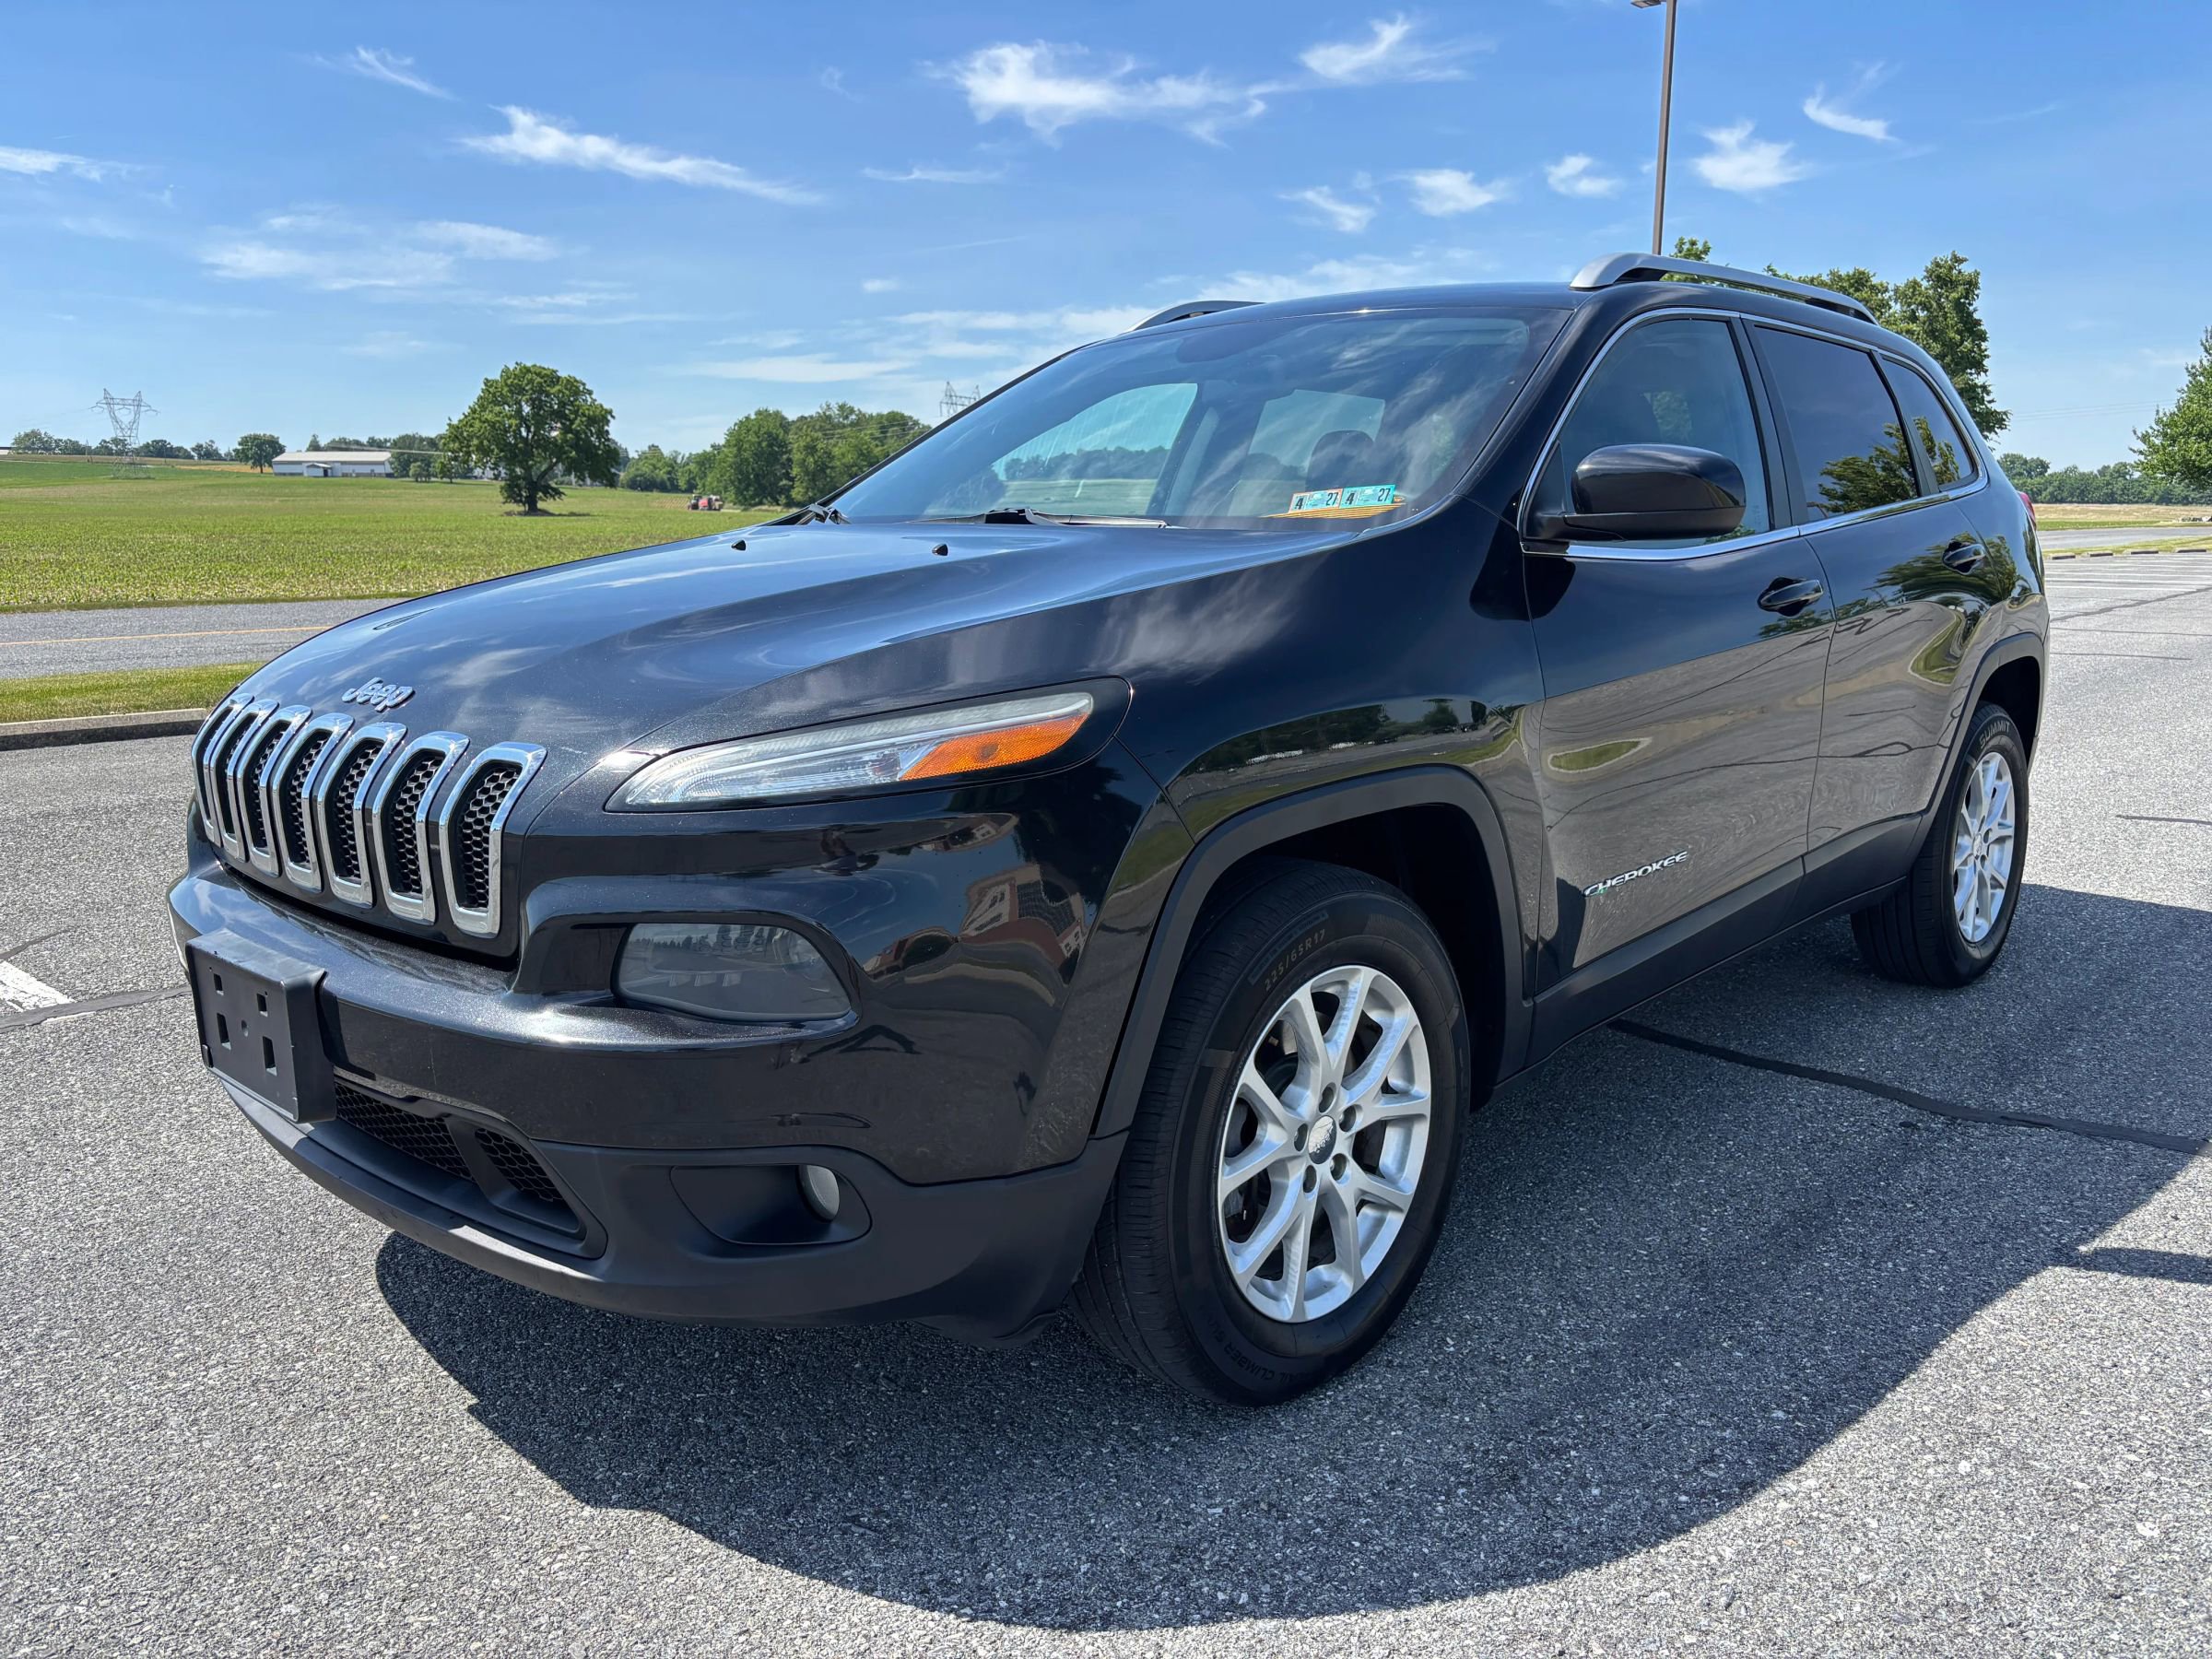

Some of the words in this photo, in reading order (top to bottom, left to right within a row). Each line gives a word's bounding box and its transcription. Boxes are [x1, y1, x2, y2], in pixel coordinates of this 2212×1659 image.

[1294, 496, 1305, 511] 4
[1325, 492, 1339, 506] 27
[1345, 492, 1356, 505] 4
[1377, 488, 1391, 502] 27
[341, 677, 414, 712] Jeep
[1979, 719, 2010, 750] SUMMIT
[1583, 850, 1688, 897] CHEROKEE
[1264, 928, 1326, 992] 225/65R17
[1223, 1340, 1276, 1382] CLIMBER
